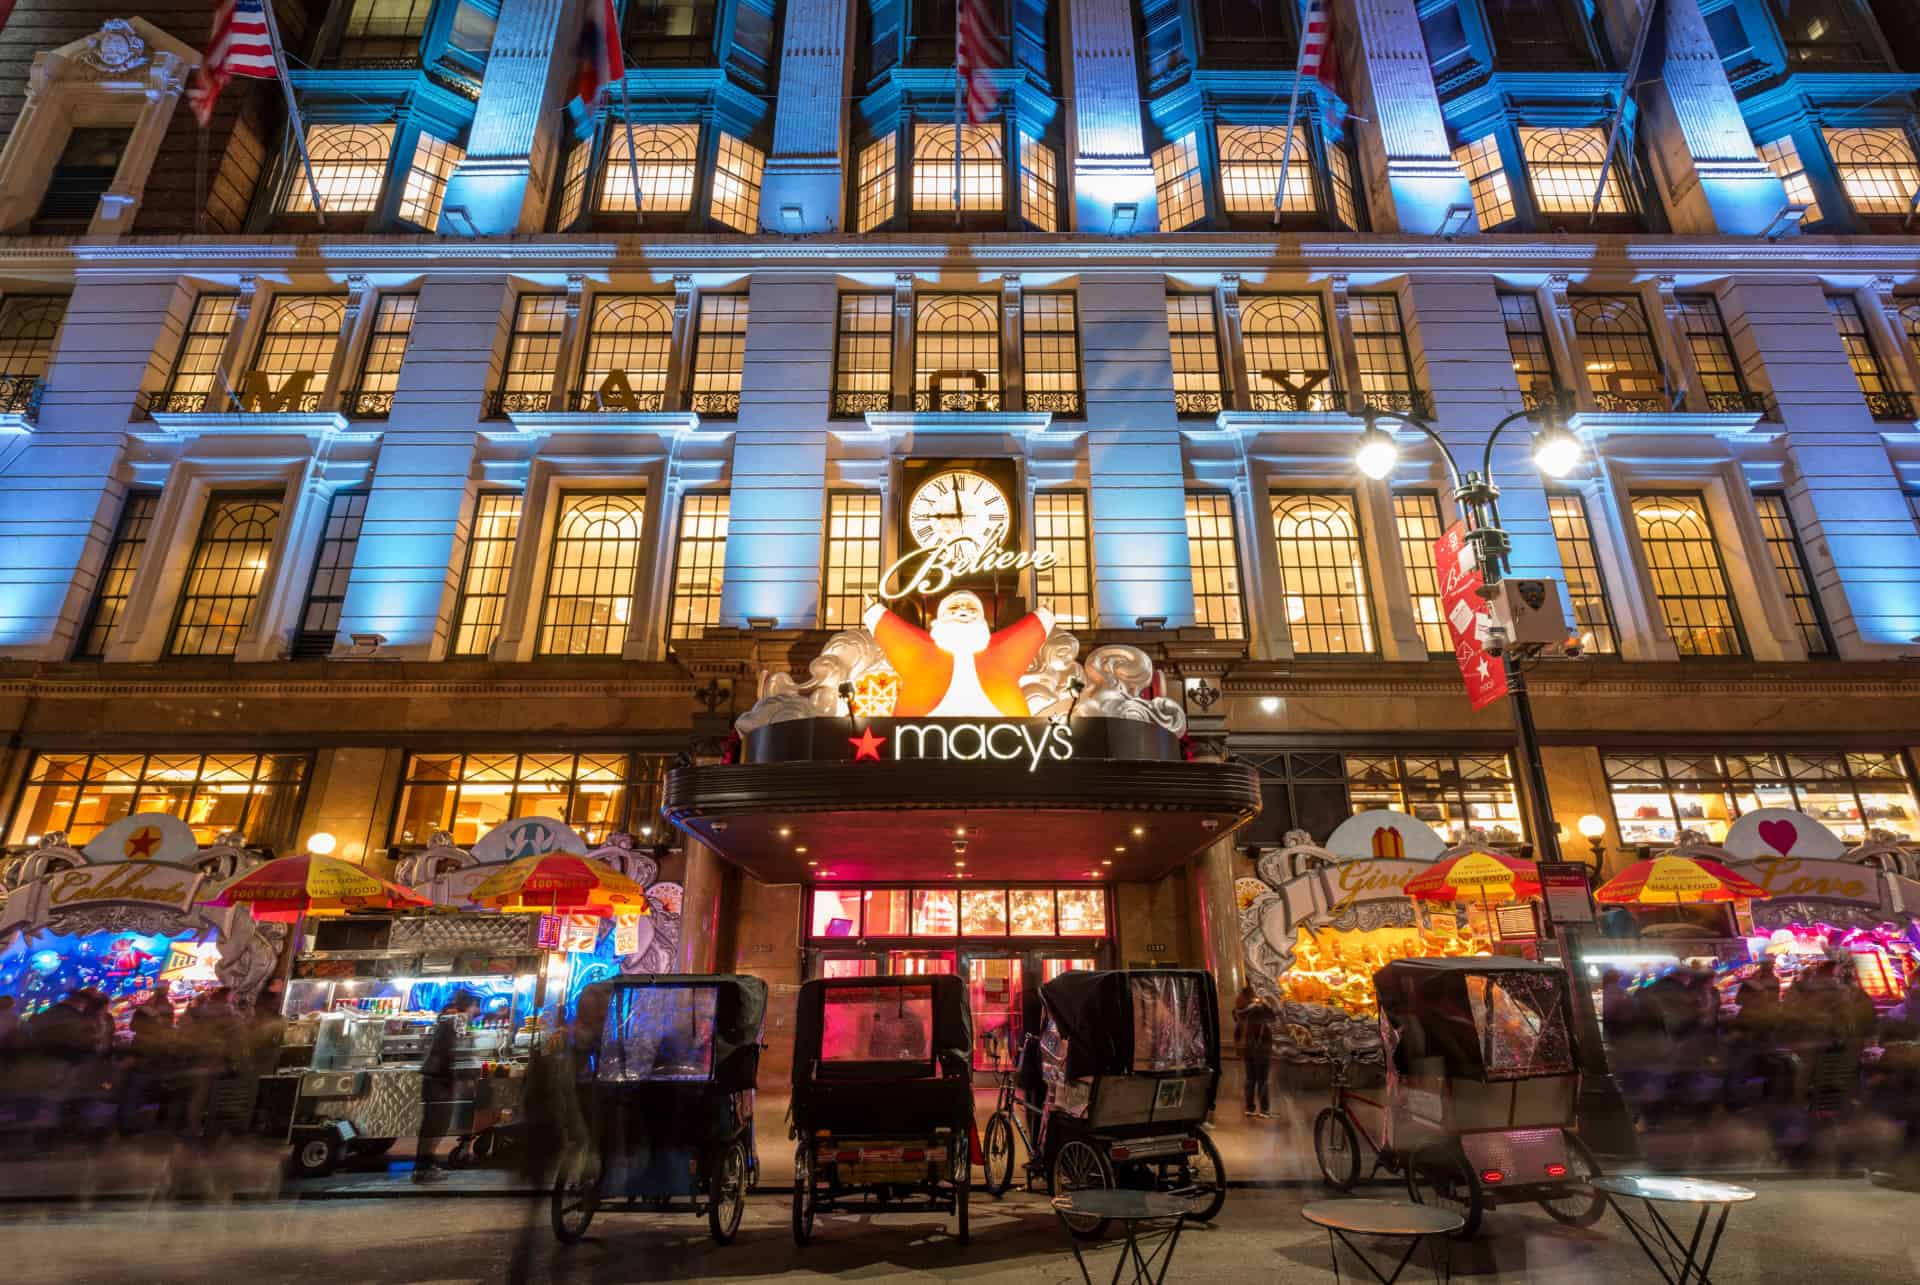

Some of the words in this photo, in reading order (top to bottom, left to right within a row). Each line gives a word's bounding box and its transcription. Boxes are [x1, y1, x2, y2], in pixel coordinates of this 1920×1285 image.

[880, 522, 1057, 599] Believe
[1481, 874, 1512, 884] FOOD
[1686, 881, 1719, 890] FOOD
[1753, 855, 1868, 897] Love
[348, 886, 378, 895] FOOD
[1327, 861, 1415, 918] Givi
